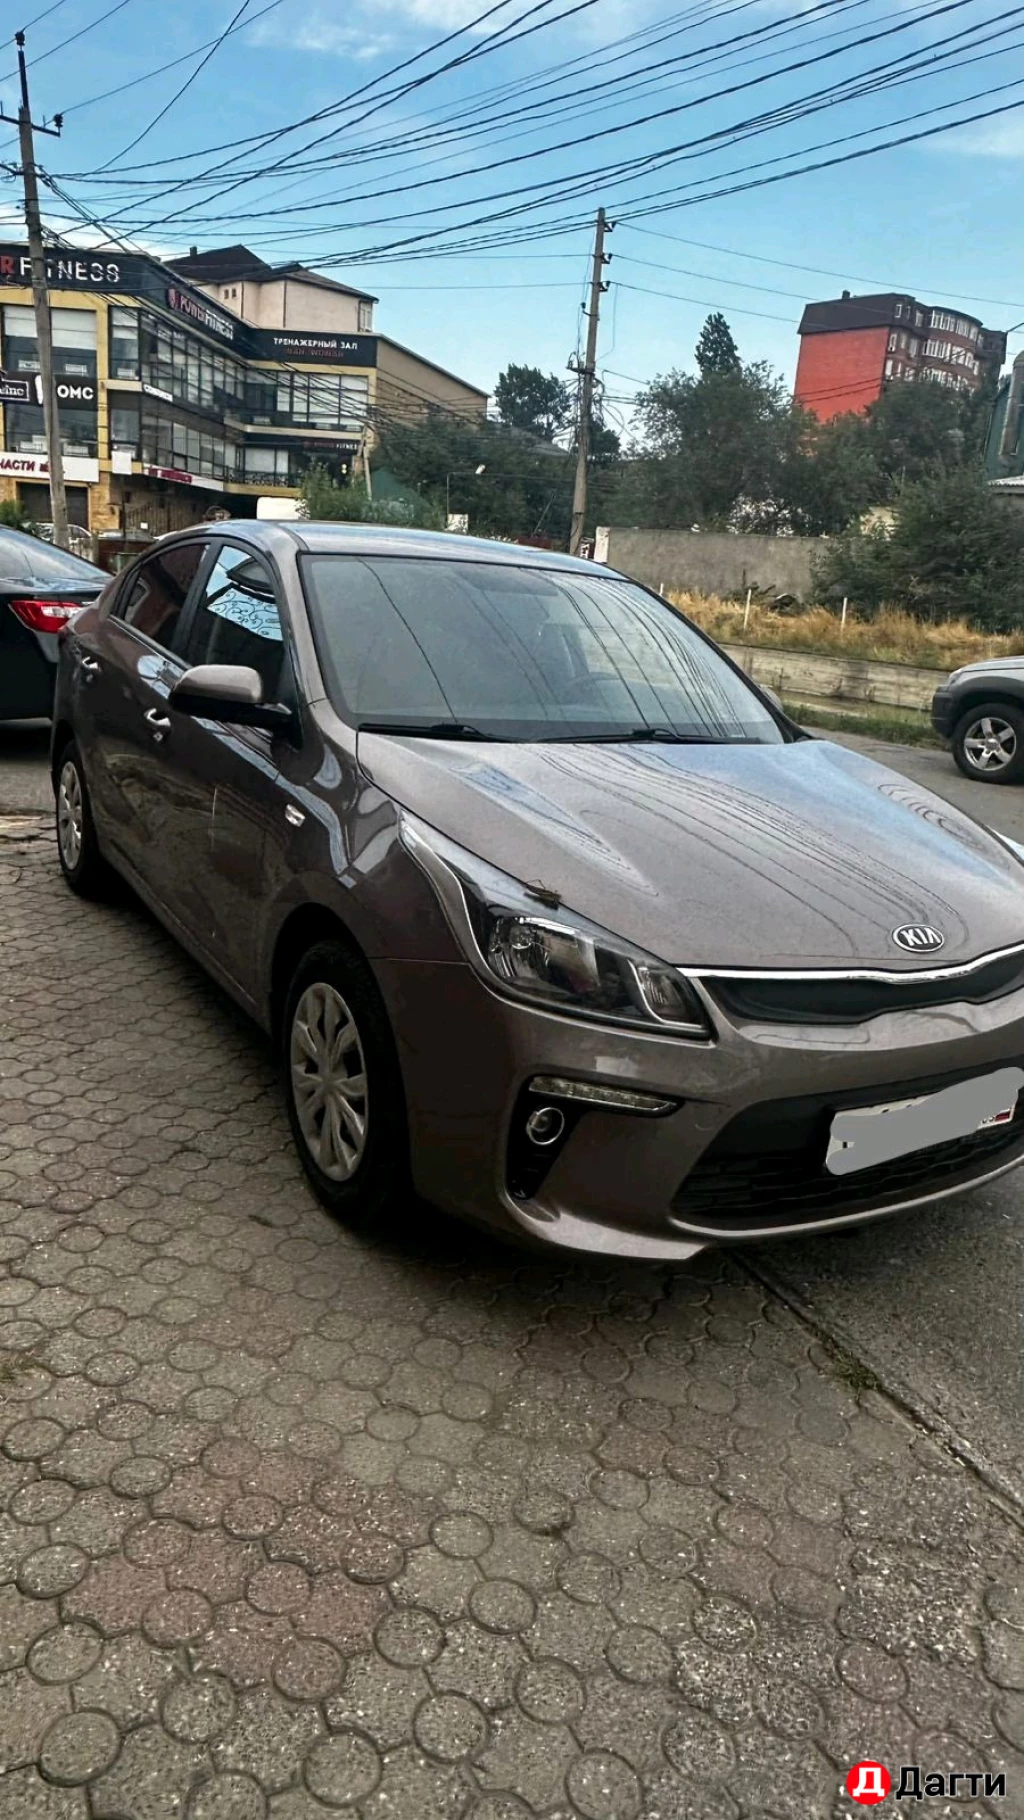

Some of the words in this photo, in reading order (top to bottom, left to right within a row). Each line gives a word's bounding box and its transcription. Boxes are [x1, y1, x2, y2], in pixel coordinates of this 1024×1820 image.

[20, 256, 120, 283] FTNESS
[273, 337, 337, 349] ТРЕНАЖЕРНЫЙ
[340, 341, 358, 350] ЗАЛ
[900, 927, 942, 946] KIA
